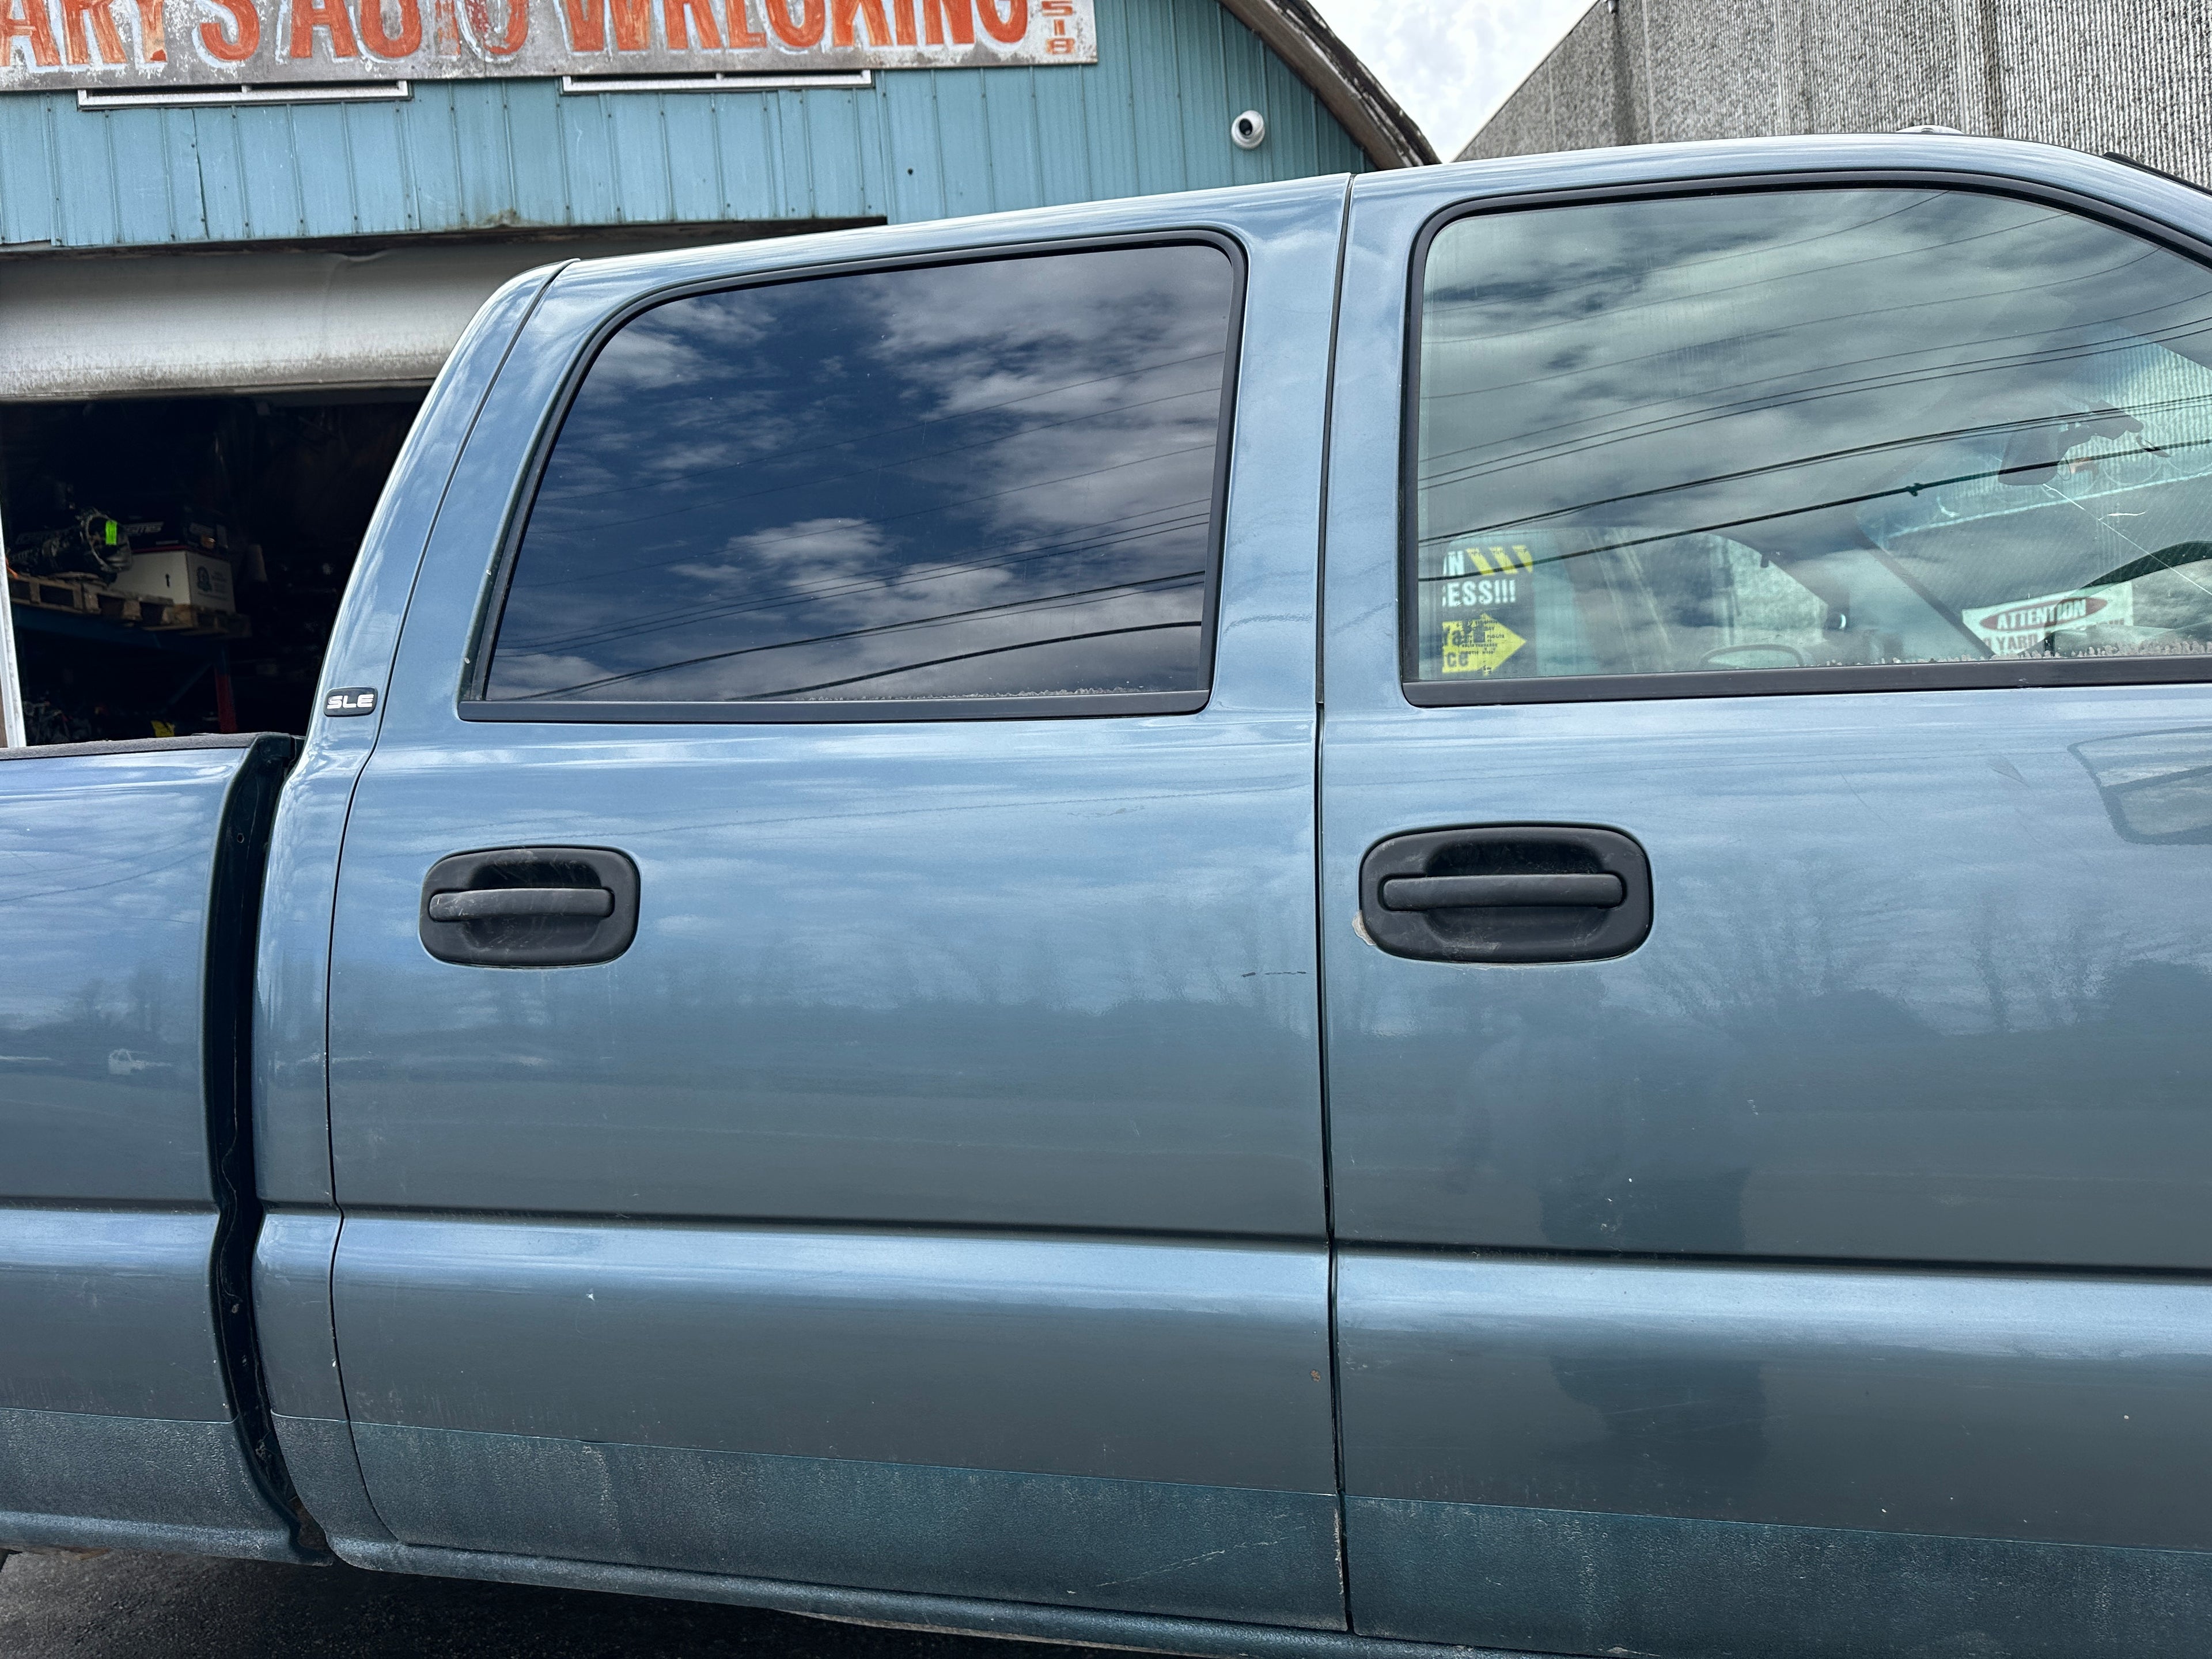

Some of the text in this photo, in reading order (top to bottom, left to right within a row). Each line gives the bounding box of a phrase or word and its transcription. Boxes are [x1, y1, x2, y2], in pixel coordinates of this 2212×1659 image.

[1442, 579, 1516, 607] ESS!!!
[1997, 599, 2087, 630] ATTENTION
[327, 694, 374, 709] SLE
